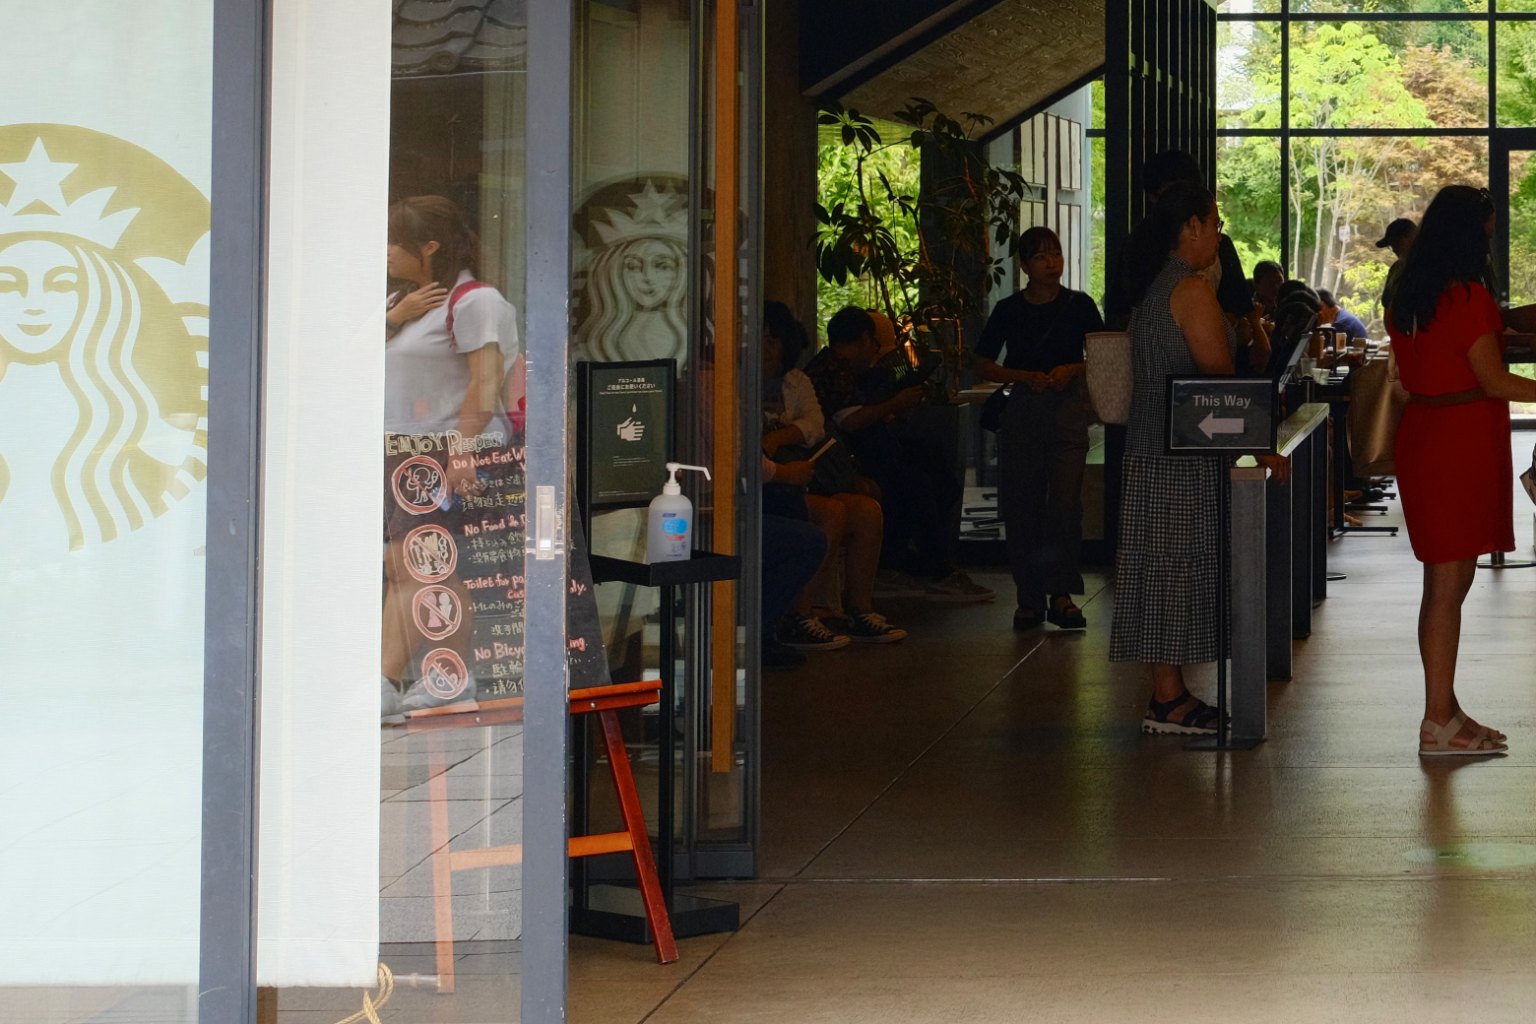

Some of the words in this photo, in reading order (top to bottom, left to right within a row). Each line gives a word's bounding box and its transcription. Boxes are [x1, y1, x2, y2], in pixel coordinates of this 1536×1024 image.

[1193, 395, 1221, 407] This
[1224, 395, 1252, 409] Way
[452, 458, 467, 469] Do
[470, 454, 491, 468] Not
[492, 451, 513, 464] Eat
[464, 524, 480, 537] No
[481, 519, 506, 532] Food
[463, 576, 495, 590] Toilet
[494, 573, 510, 586] for
[474, 647, 492, 661] No
